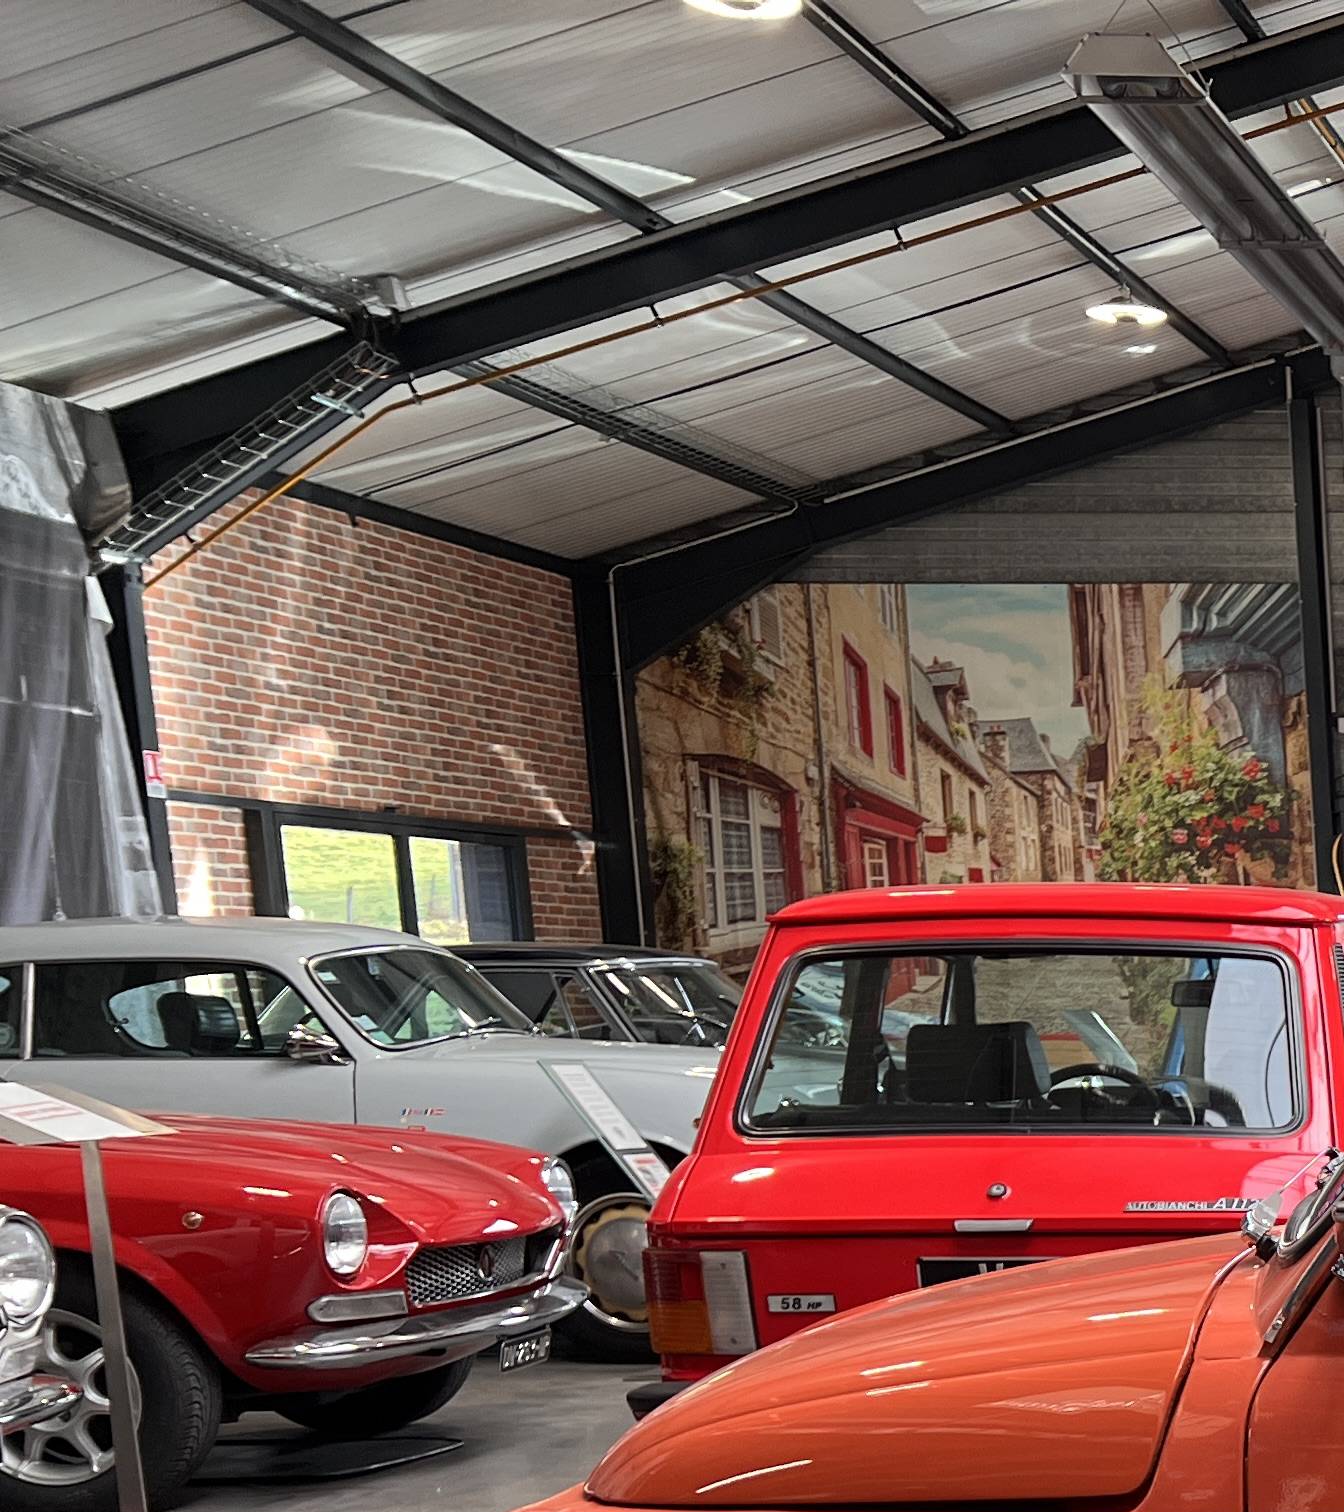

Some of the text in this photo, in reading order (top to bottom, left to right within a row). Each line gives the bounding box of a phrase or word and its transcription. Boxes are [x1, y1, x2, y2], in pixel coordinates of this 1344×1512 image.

[1125, 1201, 1208, 1211] AUTOBIANCHI
[780, 1297, 823, 1310] 58 HP
